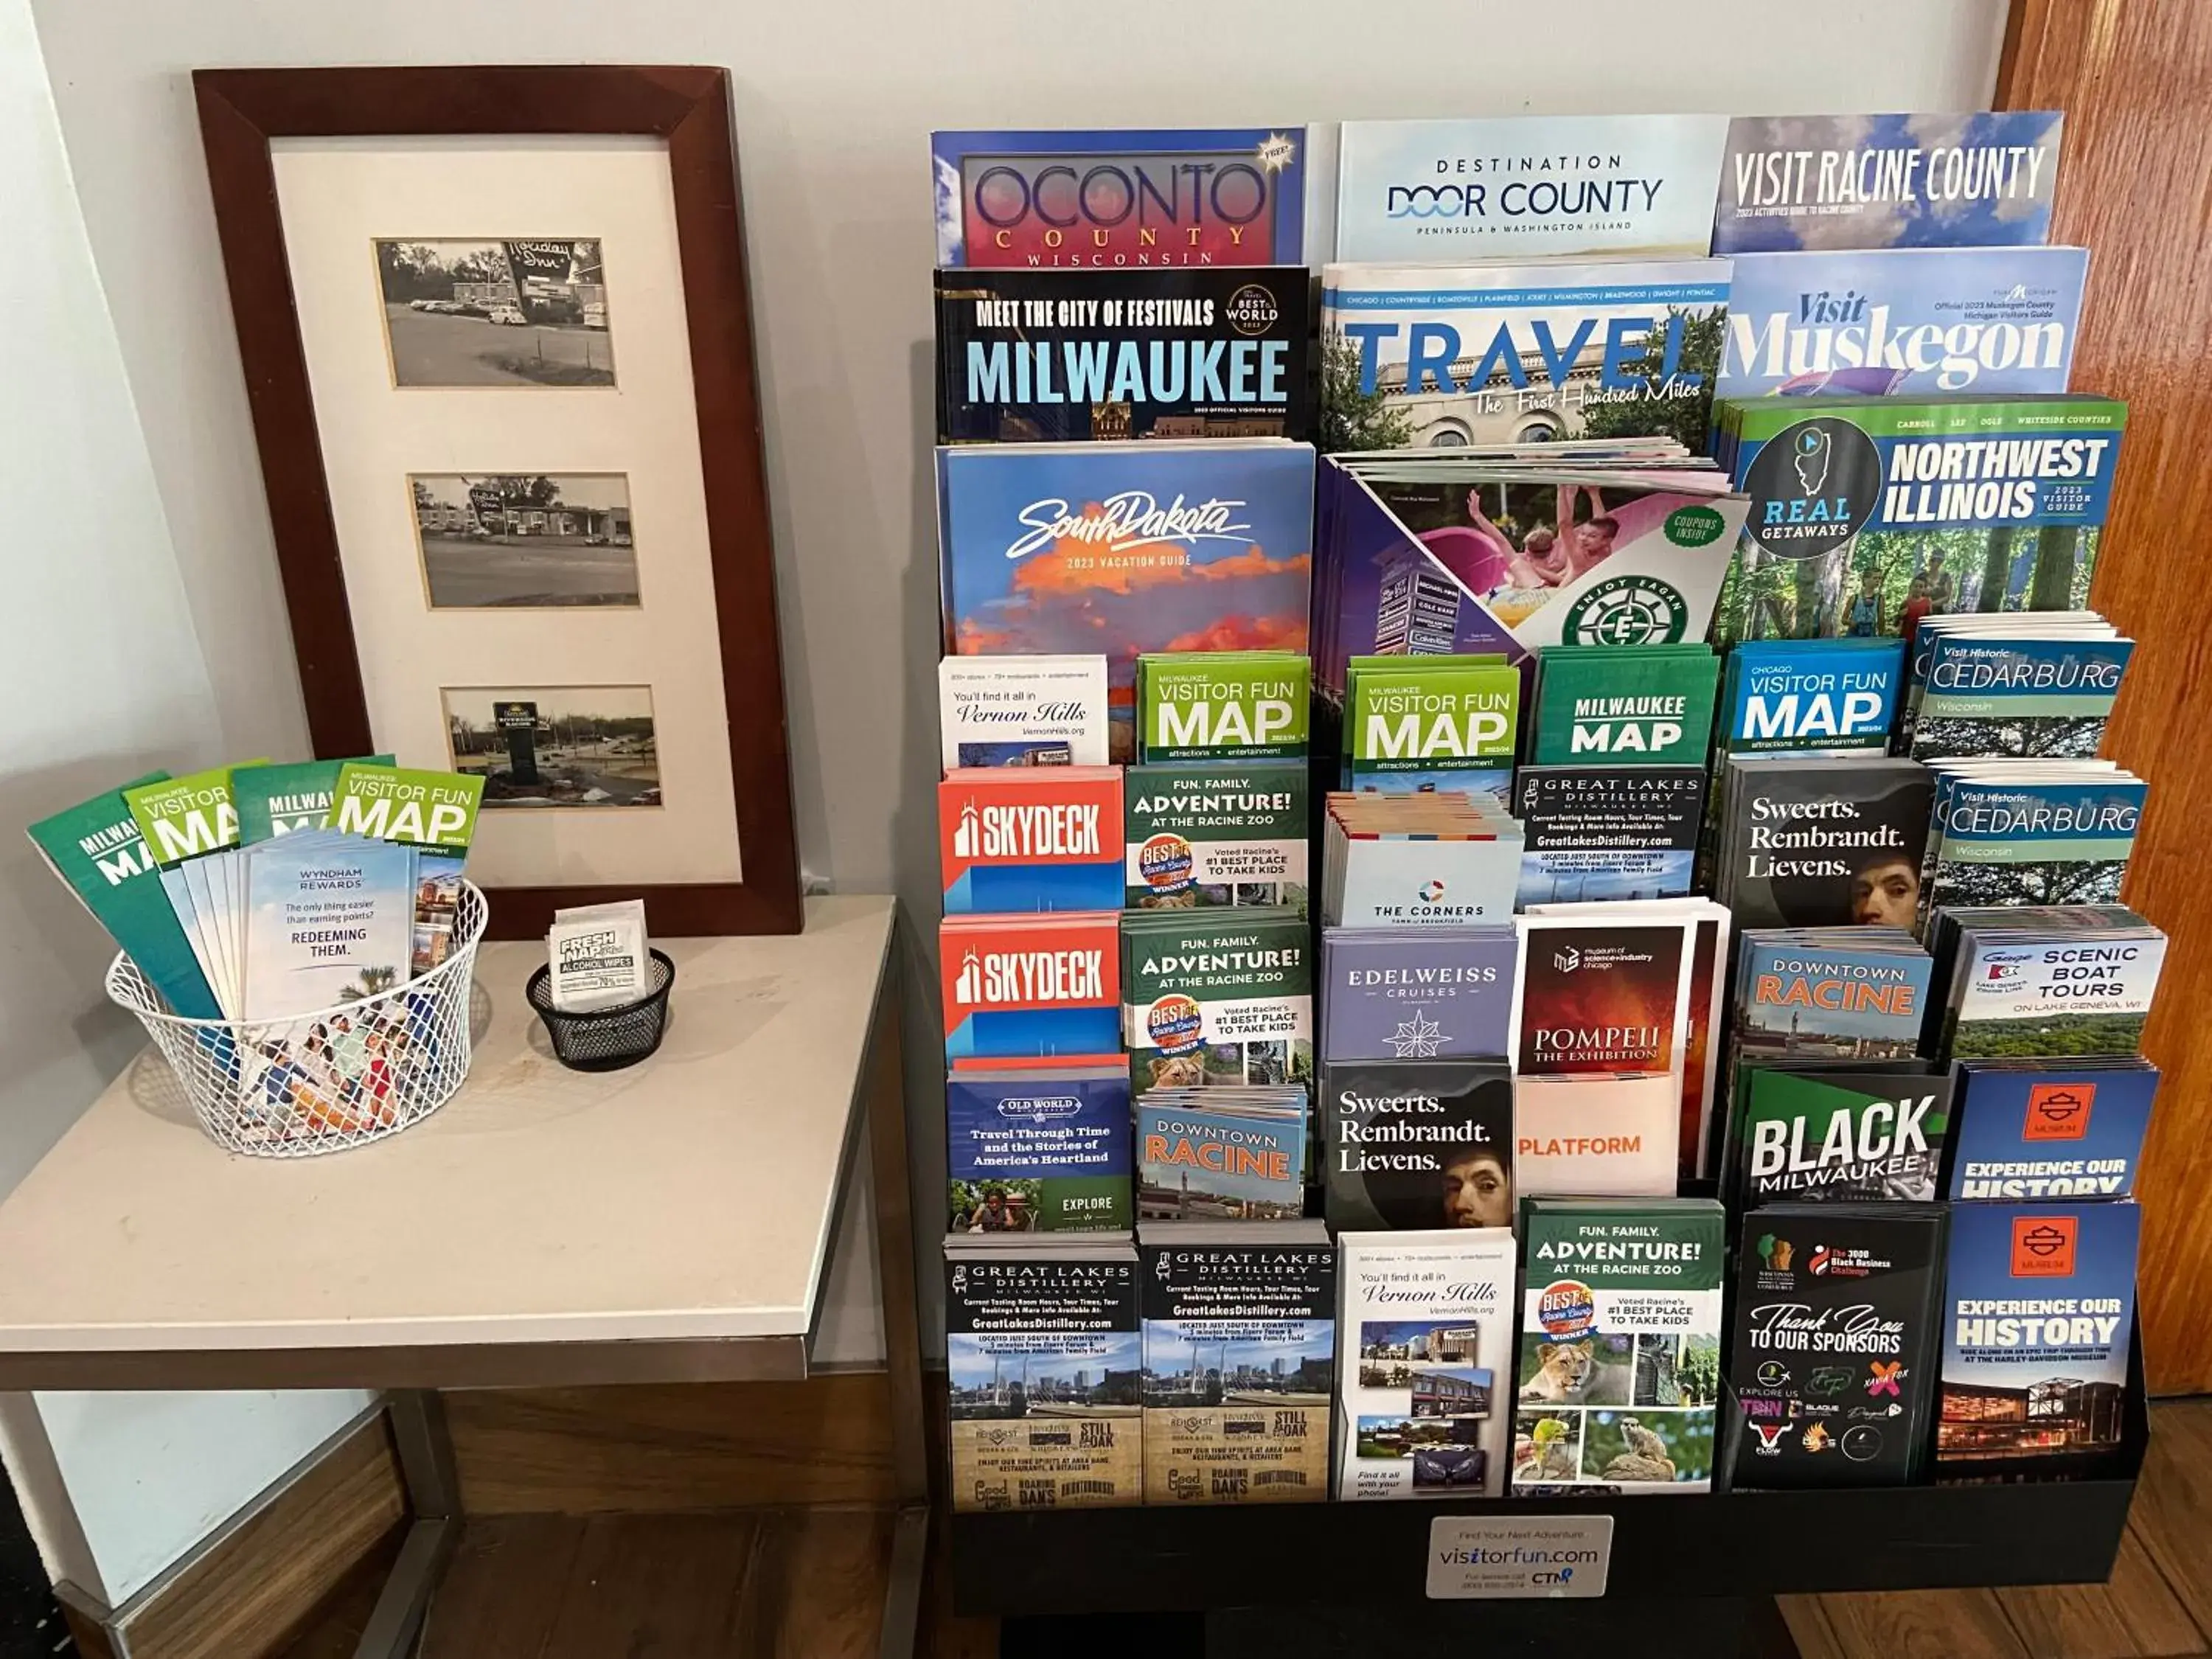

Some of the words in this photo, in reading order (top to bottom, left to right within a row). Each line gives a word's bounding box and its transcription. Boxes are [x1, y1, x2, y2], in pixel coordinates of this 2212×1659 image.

[1437, 155, 1621, 173] DESTINATION
[1735, 153, 1812, 205] VISIT
[1817, 148, 1922, 202] RACINE
[1927, 146, 2045, 201] COUNTY
[975, 163, 1266, 227] OCONTO
[1387, 184, 1486, 218] DOOR
[1500, 179, 1663, 215] COUNTY
[1503, 223, 1584, 233] WASHINGTON
[1590, 222, 1632, 230] ISLAND
[995, 226, 1245, 248] COUNTY
[1028, 252, 1213, 267] WISCONSIN
[1239, 299, 1265, 308] BEST
[1799, 290, 1868, 324] Visit
[1986, 302, 2025, 310] Muskegon
[2026, 301, 2055, 309] County
[976, 301, 1019, 327] MEET
[1025, 301, 1054, 327] THE
[1058, 300, 1098, 327] CITY
[1103, 300, 1123, 327] OF
[1128, 299, 1214, 327] FESTIVALS
[1225, 309, 1278, 321] WORLD
[1964, 312, 1998, 320] Michigan
[1345, 315, 1703, 395] TRAVEL
[1718, 305, 2065, 390] Muskegon
[967, 341, 1288, 403] MILWAUKEE
[1466, 391, 1503, 414] The
[1515, 387, 1554, 411] First
[1562, 383, 1638, 406] Hundred
[1645, 374, 1700, 401] Miles
[2017, 417, 2065, 425] WHITESIDE
[1889, 439, 2108, 481] NORTHWEST
[1882, 481, 2037, 523] ILLINOIS
[2042, 494, 2092, 503] VISITOR
[1764, 498, 1851, 524] REAL
[2046, 503, 2084, 511] GUIDE
[1674, 516, 1717, 529] COUPONS
[1676, 528, 1708, 540] INSIDE
[1761, 524, 1848, 540] GETAWAYS
[1067, 558, 1094, 568] 2023
[1100, 556, 1154, 568] VACATION
[1160, 555, 1192, 566] GUIDE
[1576, 580, 1627, 612] ENJOY
[1638, 580, 1683, 612] EAGAN
[1944, 647, 1969, 658] Visit
[1971, 648, 2009, 658] Historic
[1751, 666, 1792, 674] CHICAGO
[1933, 664, 2120, 688] CEDARBURG
[1750, 675, 1834, 692] VISITOR
[1842, 672, 1887, 690] FUN
[954, 692, 980, 702] You'll
[983, 692, 1001, 701] find
[1003, 692, 1009, 700] it
[1012, 692, 1024, 700] all
[1027, 692, 1036, 700] in
[1159, 684, 1242, 700] VISITOR
[1252, 683, 1294, 699] FUN
[957, 704, 1027, 723] Vernon
[1033, 702, 1086, 720] Hills
[1576, 696, 1686, 717] MILWAUKEE
[1937, 700, 1993, 712] Wisconsin
[1742, 692, 1882, 738] MAP
[1158, 701, 1293, 746] MAP
[1023, 728, 1085, 736] VernonHills.org
[1571, 723, 1682, 753] MAP
[349, 780, 427, 801] VISITOR
[431, 787, 473, 805] FUN
[1752, 797, 1860, 820] Sweerts.
[338, 796, 467, 844] MAP
[984, 805, 1099, 855] SKYDECK
[1750, 826, 1905, 849] Rembrandt.
[300, 870, 362, 878] WYNDHAM
[1747, 856, 1851, 877] Lievens.
[300, 880, 361, 890] REWARDS
[303, 903, 321, 913] only
[324, 902, 346, 913] thing
[1374, 907, 1402, 916] THE
[1411, 907, 1484, 916] CORNERS
[287, 915, 307, 924] than
[309, 914, 341, 925] earning
[343, 911, 374, 923] points?
[292, 929, 366, 944] REDEEMING
[560, 931, 614, 953] FRESH
[311, 945, 351, 957] THEM.
[564, 947, 600, 962] NAP
[1584, 954, 1652, 963] science+industry
[2044, 947, 2138, 964] SCENIC
[562, 959, 603, 973] ALCOHOL
[605, 957, 632, 967] WIPES
[2053, 966, 2121, 980] BOAT
[1349, 967, 1497, 986] EDELWEISS
[1387, 988, 1456, 998] CRUISES
[2039, 983, 2124, 998] TOURS
[2035, 1003, 2067, 1011] LAKE
[2070, 1002, 2122, 1010] GENEVA,
[1534, 1026, 1660, 1050] POMPEII
[1534, 1051, 1564, 1061] THE
[1569, 1049, 1658, 1061] EXHIBITION
[1008, 1099, 1032, 1110] OLD
[1034, 1099, 1073, 1109] WORLD
[971, 1129, 1013, 1139] Travel
[1016, 1129, 1074, 1139] Through
[1077, 1127, 1110, 1137] Time
[1158, 1121, 1276, 1148] DOWNTOWN
[1750, 1095, 1936, 1178] BLACK
[984, 1141, 1008, 1152] and
[1011, 1141, 1033, 1151] the
[1036, 1141, 1082, 1151] Stories
[1085, 1140, 1098, 1150] of
[1519, 1136, 1641, 1155] PLATFORM
[973, 1155, 1039, 1166] America's
[1041, 1153, 1108, 1164] Heartland
[1145, 1135, 1290, 1180] RACINE
[1759, 1155, 1925, 1194] MILWAUKEE
[1062, 1197, 1113, 1211] EXPLORE
[1579, 1226, 1608, 1237] FUN.
[1612, 1226, 1659, 1237] FAMILY.
[1177, 1254, 1252, 1264] GREAT
[1259, 1253, 1332, 1264] LAKES
[1537, 1242, 1701, 1261] ADVENTURE!
[1554, 1265, 1570, 1273] AT
[1573, 1265, 1598, 1273] THE
[1602, 1265, 1650, 1275] RACINE
[1655, 1265, 1682, 1275] ZOO
[1544, 1291, 1579, 1311] BEST
[1648, 1298, 1684, 1306] Racine's
[1958, 1300, 2077, 1315] EXPERIENCE
[2081, 1298, 2121, 1313] OUR
[1173, 1305, 1311, 1316] GreatLakesDistillery.com
[1608, 1307, 1620, 1315] #1
[1623, 1307, 1652, 1315] BEST
[1656, 1307, 1693, 1315] PLACE
[1610, 1316, 1625, 1325] TO
[1629, 1316, 1658, 1325] TAKE
[1663, 1316, 1689, 1325] KIDS
[1750, 1304, 1833, 1332] Thank
[1834, 1304, 1904, 1338] You
[1956, 1317, 2121, 1346] HISTORY
[1749, 1329, 1770, 1348] TO
[1775, 1331, 1808, 1349] OUR
[1812, 1332, 1901, 1353] SPONSORS
[1739, 1388, 1783, 1397] EXPLORE
[1441, 1548, 1598, 1564] visitorfun.com
